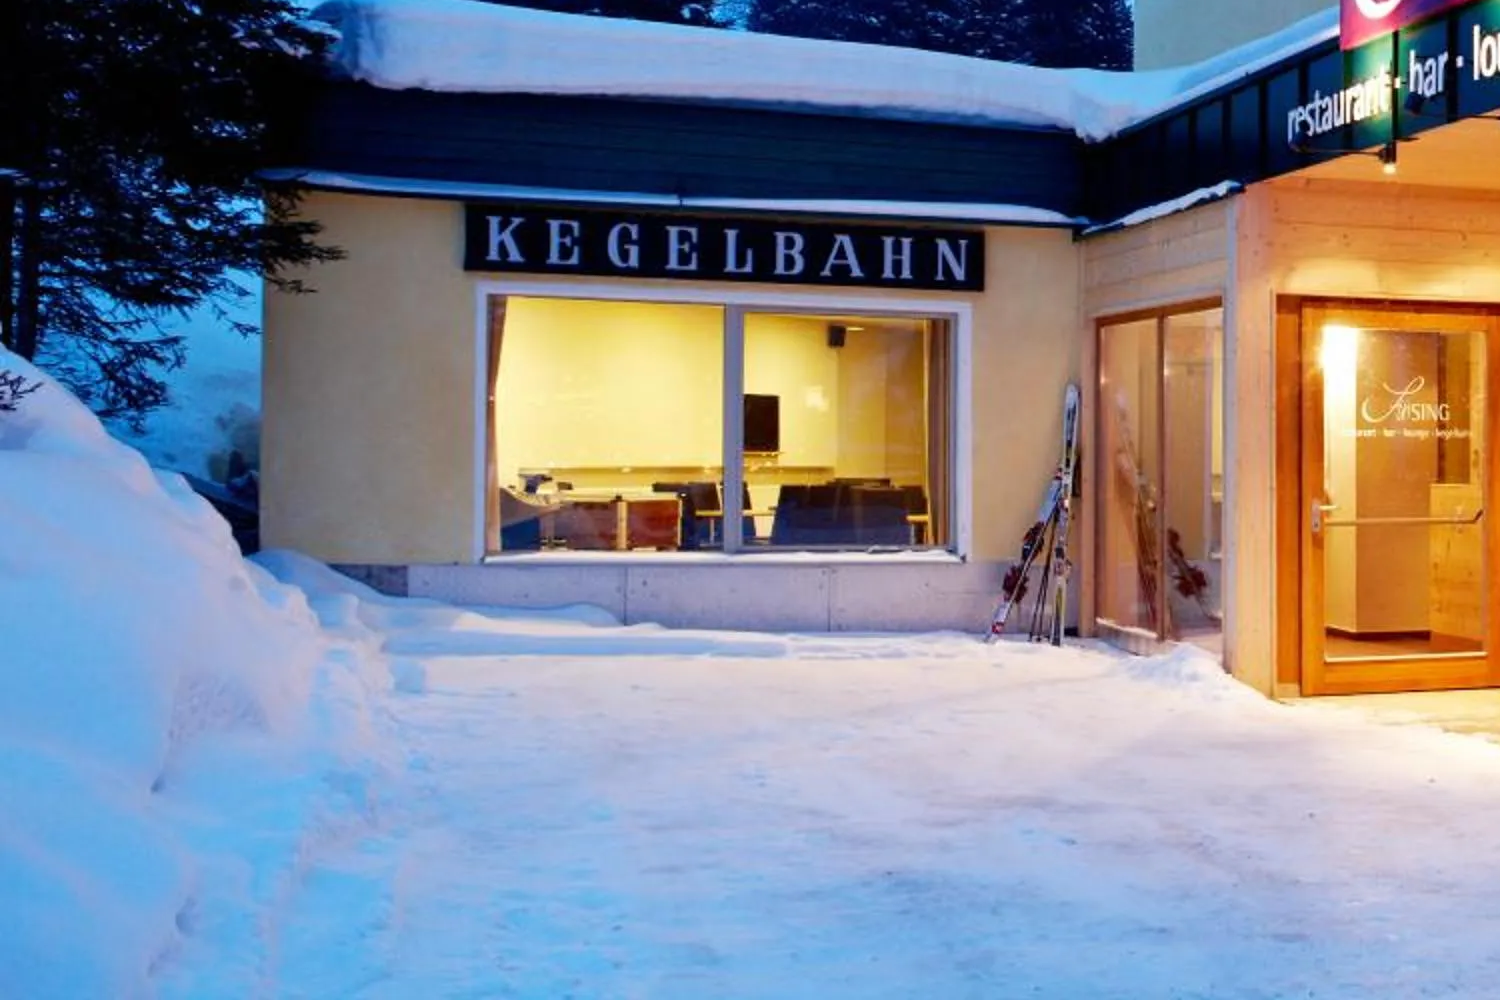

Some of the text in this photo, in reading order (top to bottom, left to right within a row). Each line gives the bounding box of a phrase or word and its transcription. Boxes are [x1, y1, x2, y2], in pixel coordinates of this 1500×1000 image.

[1287, 63, 1392, 143] restaurant
[1409, 50, 1448, 98] bar
[485, 215, 969, 282] KEGELBAHN
